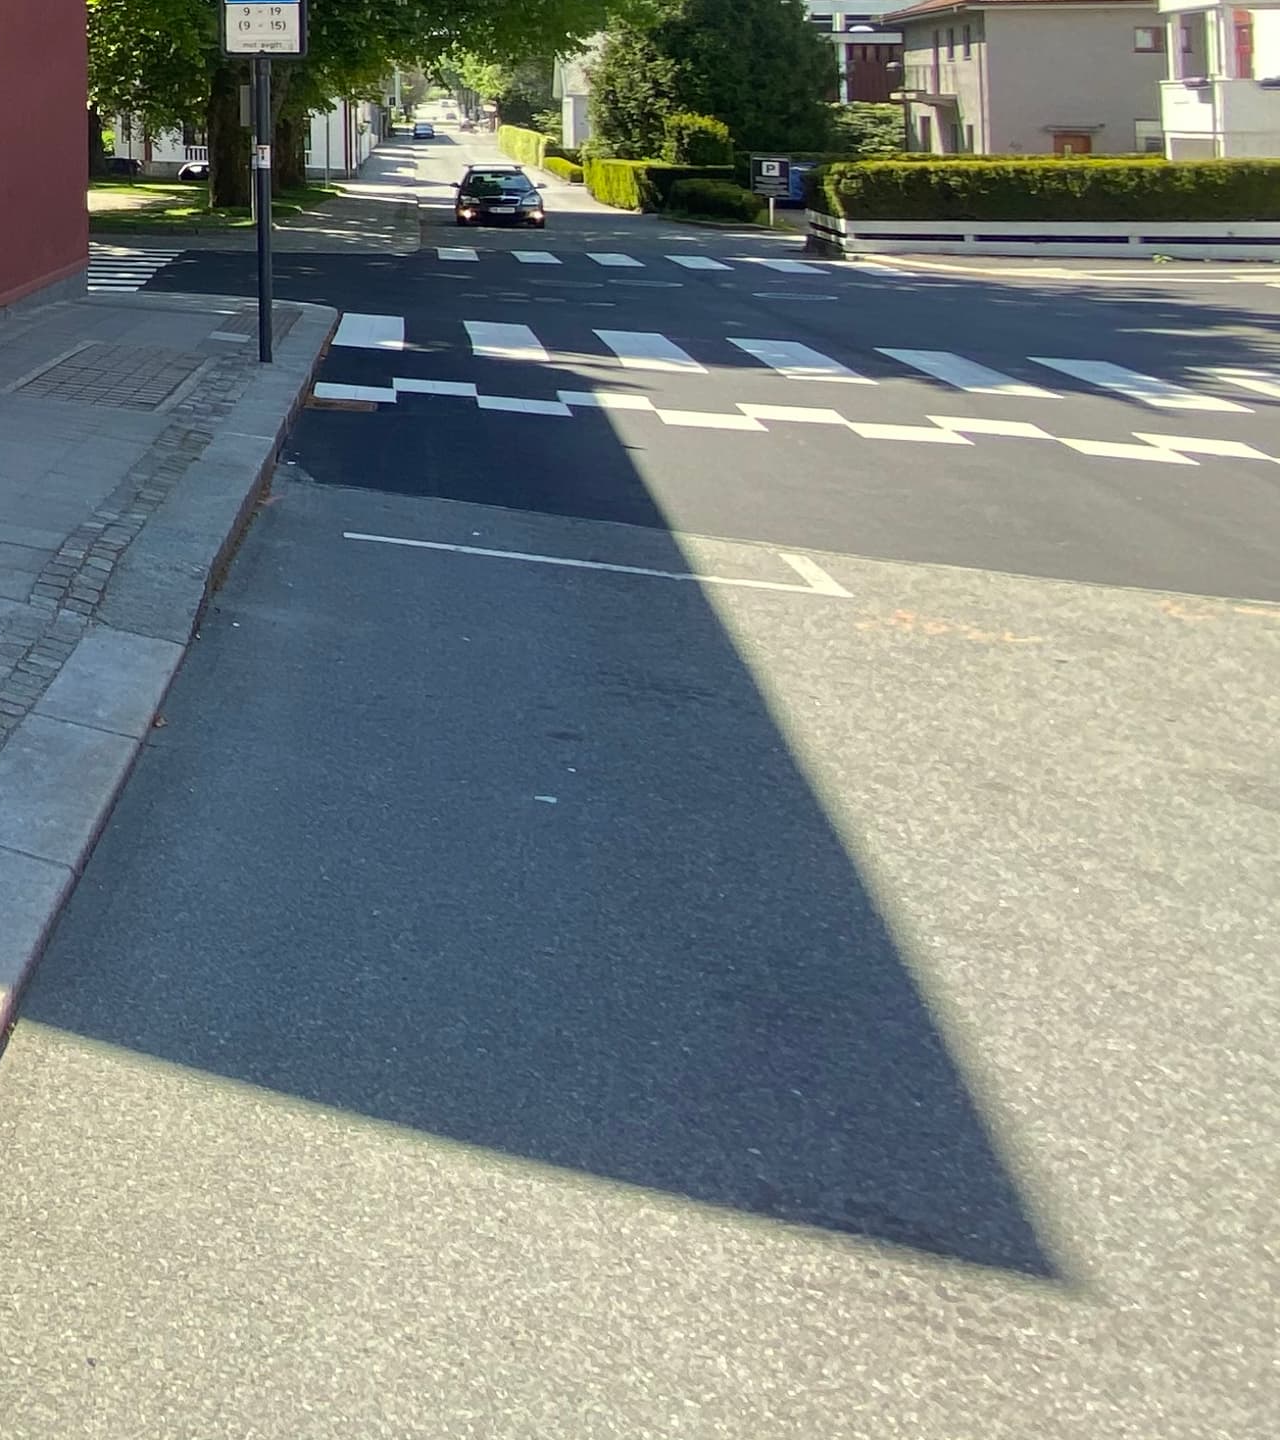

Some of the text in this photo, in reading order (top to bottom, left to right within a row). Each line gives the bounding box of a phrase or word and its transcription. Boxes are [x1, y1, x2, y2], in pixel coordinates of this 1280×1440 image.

[243, 7, 251, 16] 9
[270, 7, 282, 16] 19
[238, 20, 251, 31] (9
[270, 20, 287, 31] 15)
[766, 164, 776, 173] P
